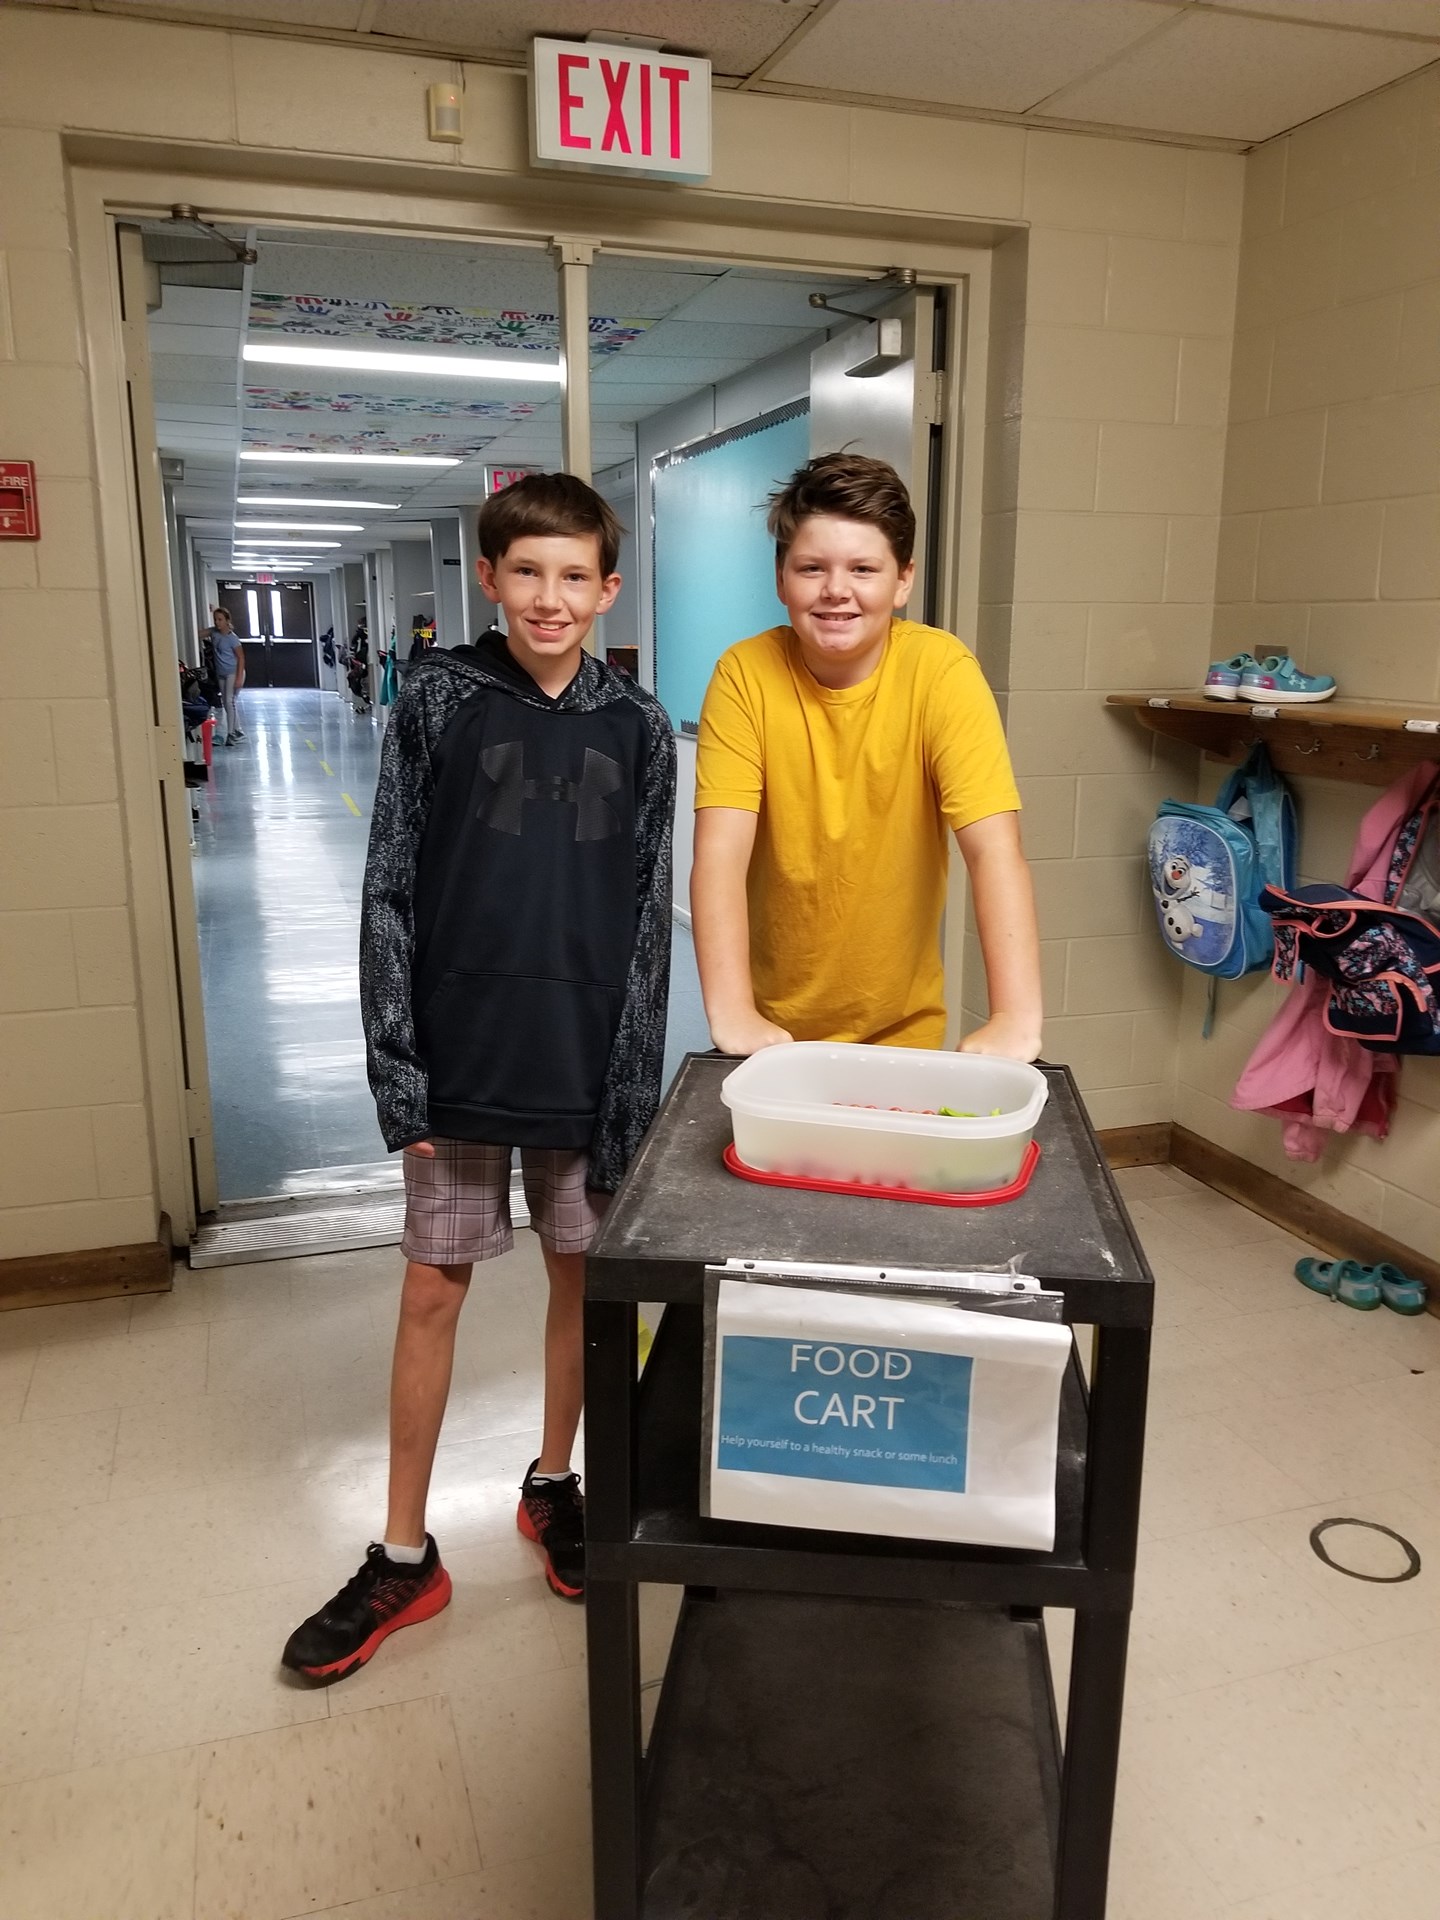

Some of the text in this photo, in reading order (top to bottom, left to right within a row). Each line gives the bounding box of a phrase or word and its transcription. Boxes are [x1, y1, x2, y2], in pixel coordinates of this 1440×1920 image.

[558, 53, 690, 160] EXIT
[790, 1344, 912, 1380] FOOD
[794, 1390, 905, 1430] CART
[720, 1434, 958, 1465] Help yourself to a healthy snack or some lunch
